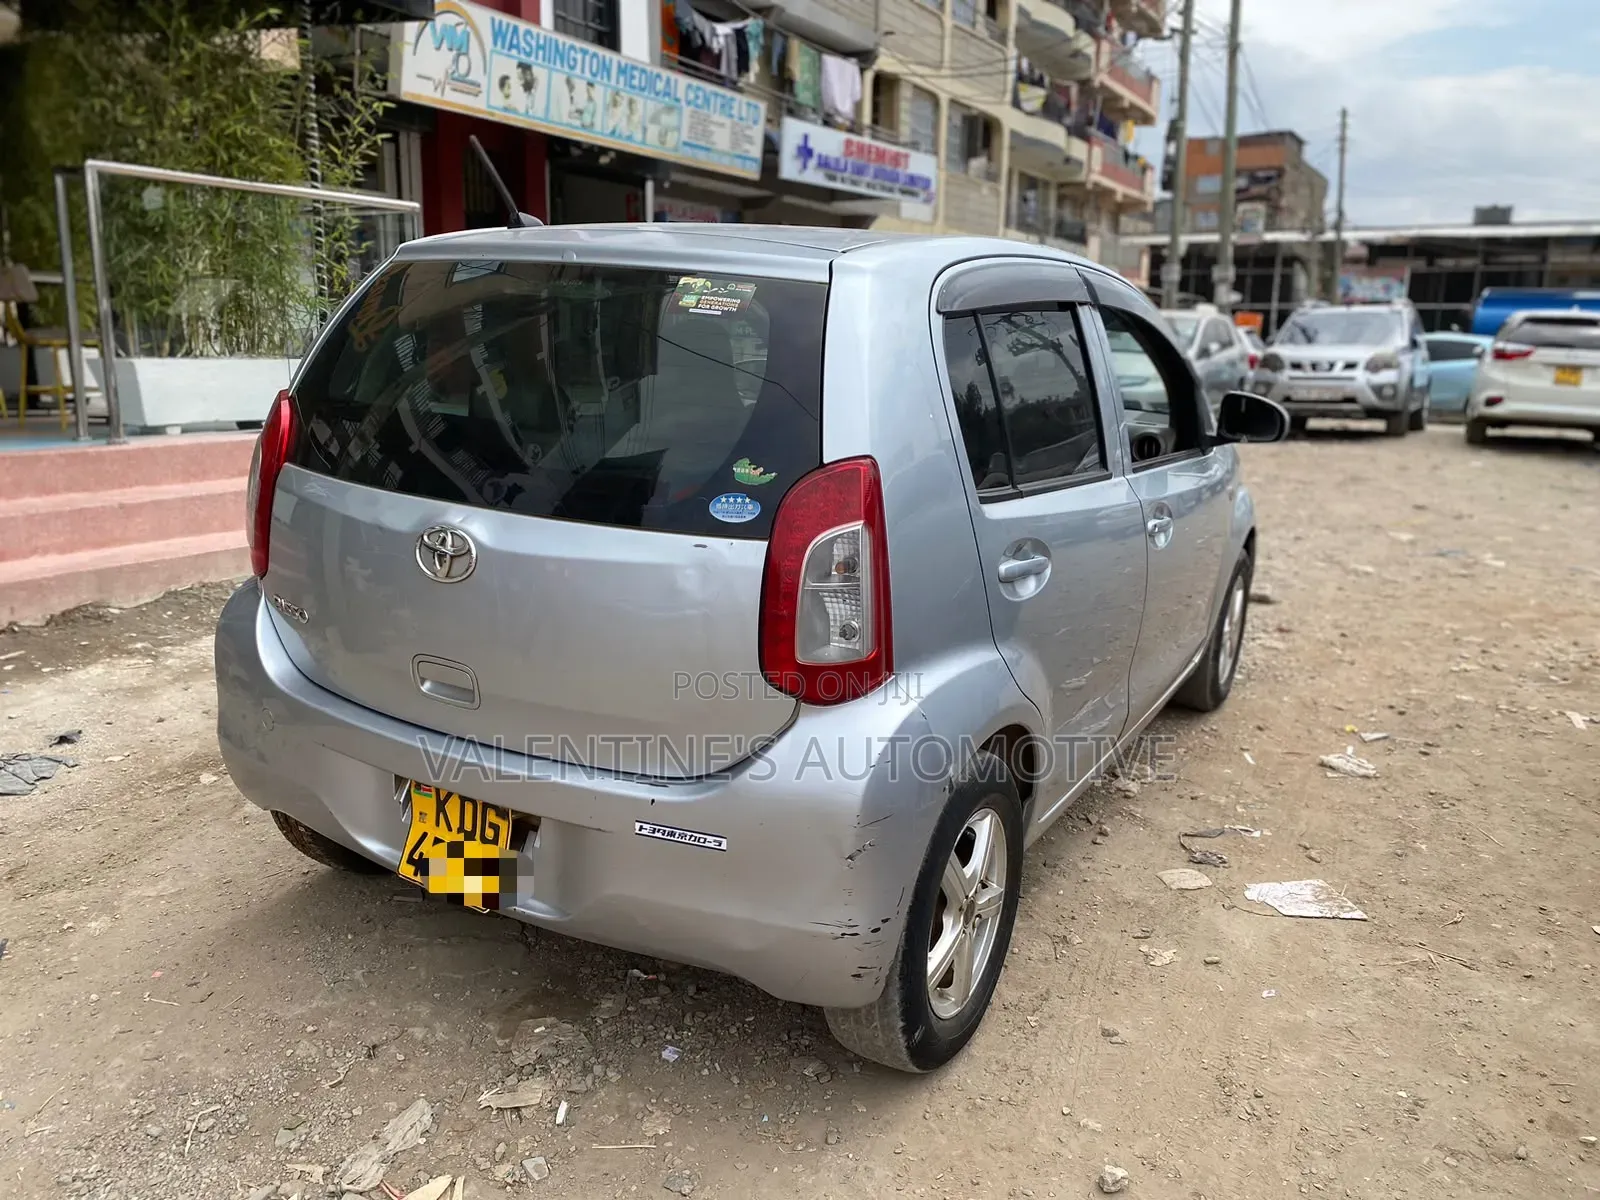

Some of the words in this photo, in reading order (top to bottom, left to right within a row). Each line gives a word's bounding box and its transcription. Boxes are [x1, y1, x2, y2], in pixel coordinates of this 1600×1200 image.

[490, 16, 612, 82] WASHINGTON
[616, 58, 681, 103] MEDICAL
[685, 83, 735, 118] CENTRE
[738, 98, 761, 127] LTD
[699, 300, 739, 308] GENERATIONS
[701, 295, 740, 304] EMPOWERING
[434, 788, 508, 846] KDG
[638, 825, 723, 847] トヨタ東京カローラ
